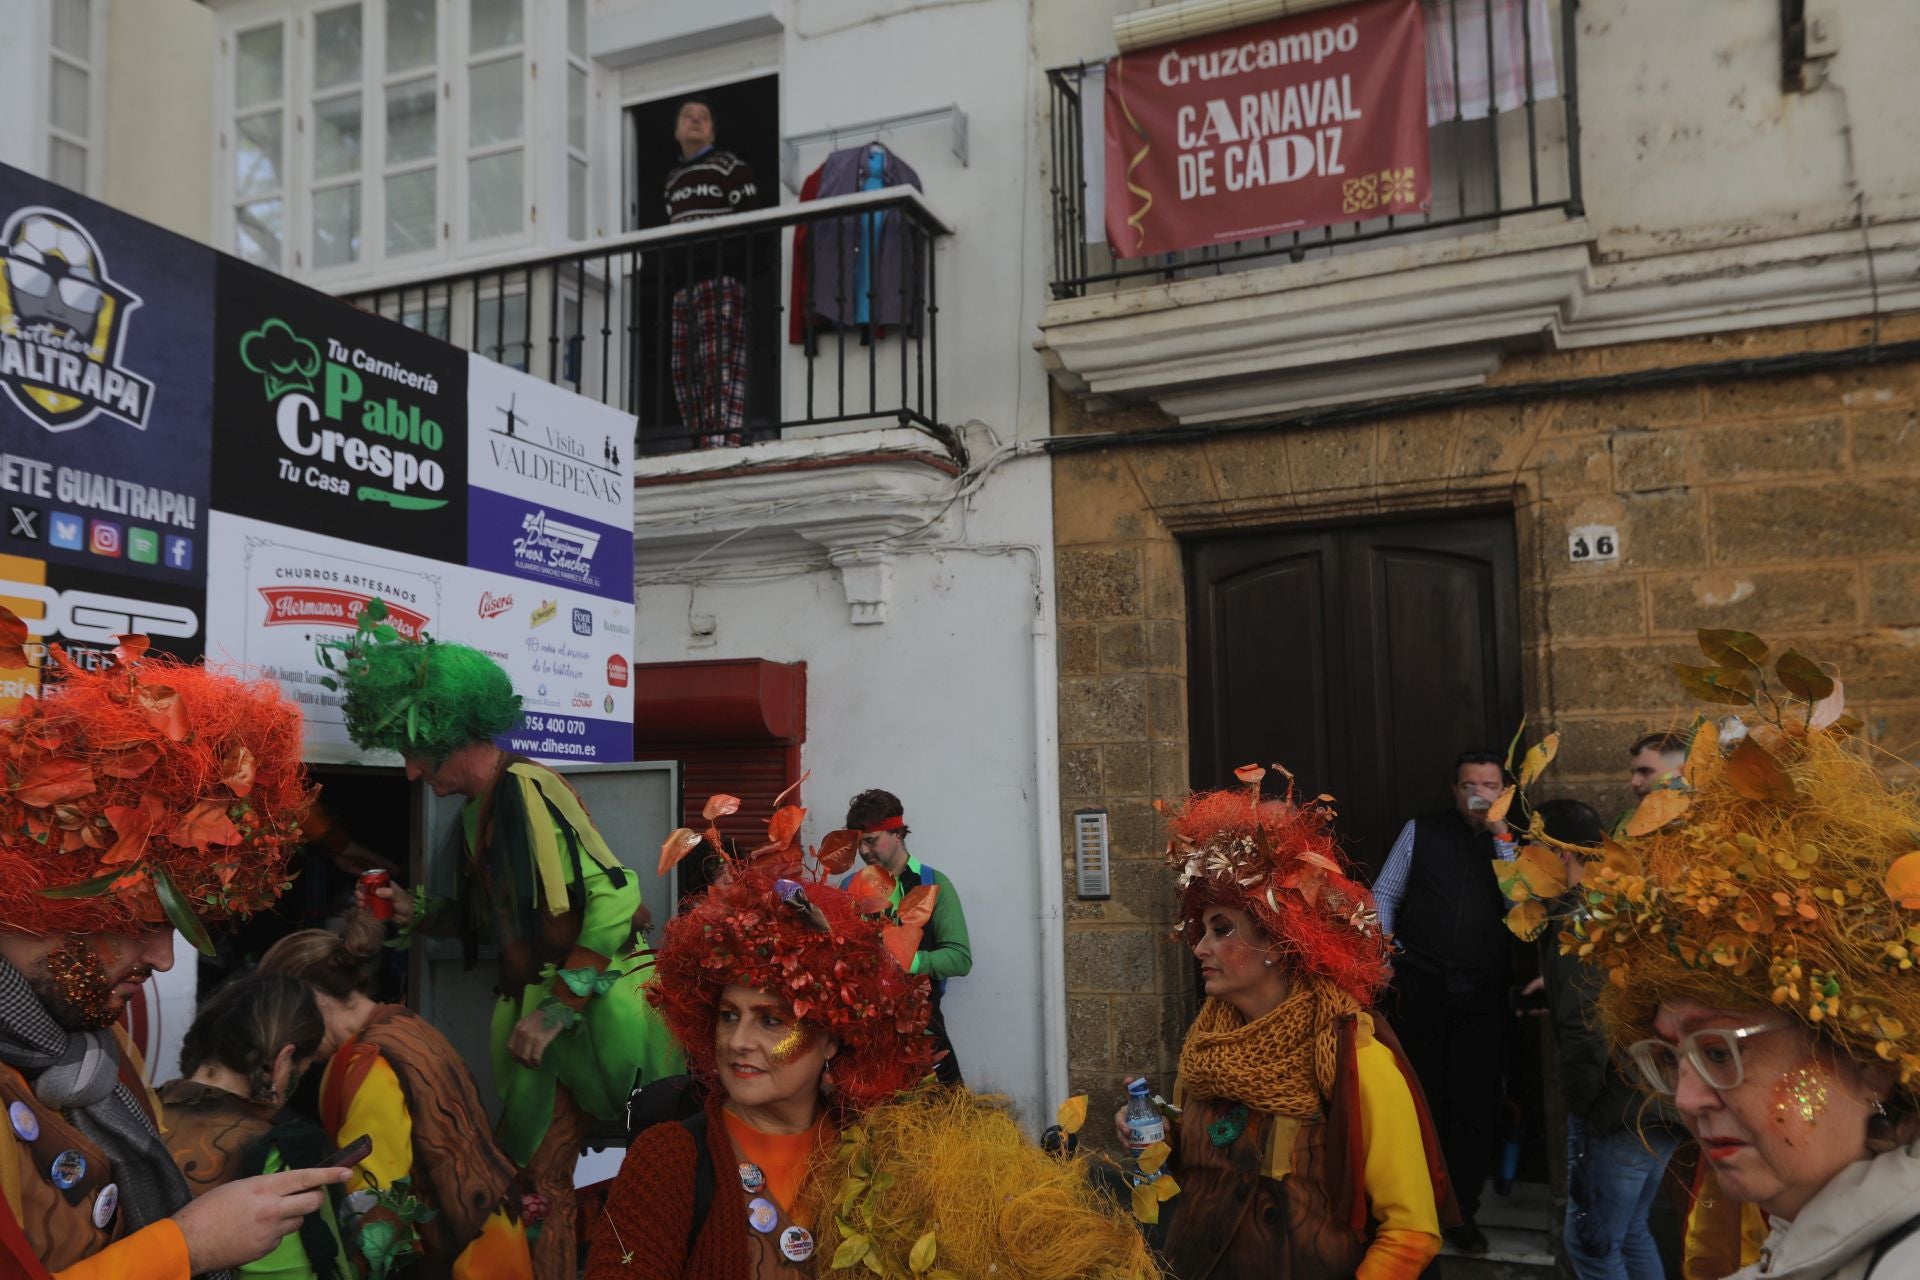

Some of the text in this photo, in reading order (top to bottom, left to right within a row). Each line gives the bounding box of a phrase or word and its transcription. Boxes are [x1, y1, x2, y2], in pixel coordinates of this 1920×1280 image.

[1158, 20, 1359, 87] Cruzcampo
[1177, 74, 1362, 150] CARNAVAL
[1177, 150, 1217, 200] DE
[0, 336, 141, 418] ALTRAPA
[328, 338, 439, 395] Tu Carnicería
[325, 361, 444, 452] Pablo
[276, 393, 445, 492] Crespo
[545, 427, 586, 458] Visita
[0, 453, 196, 530] ETE GUALTRAPA!
[278, 458, 351, 496] Tu Casa
[490, 439, 623, 506] VALDEPEÑAS
[275, 567, 417, 604] CHURROS ARTESANOS
[275, 596, 344, 617] Hermanos
[573, 610, 591, 624] Font
[573, 621, 592, 636] Vella
[511, 738, 596, 757] www.dihesan.es
[524, 715, 585, 736] 956 400 070
